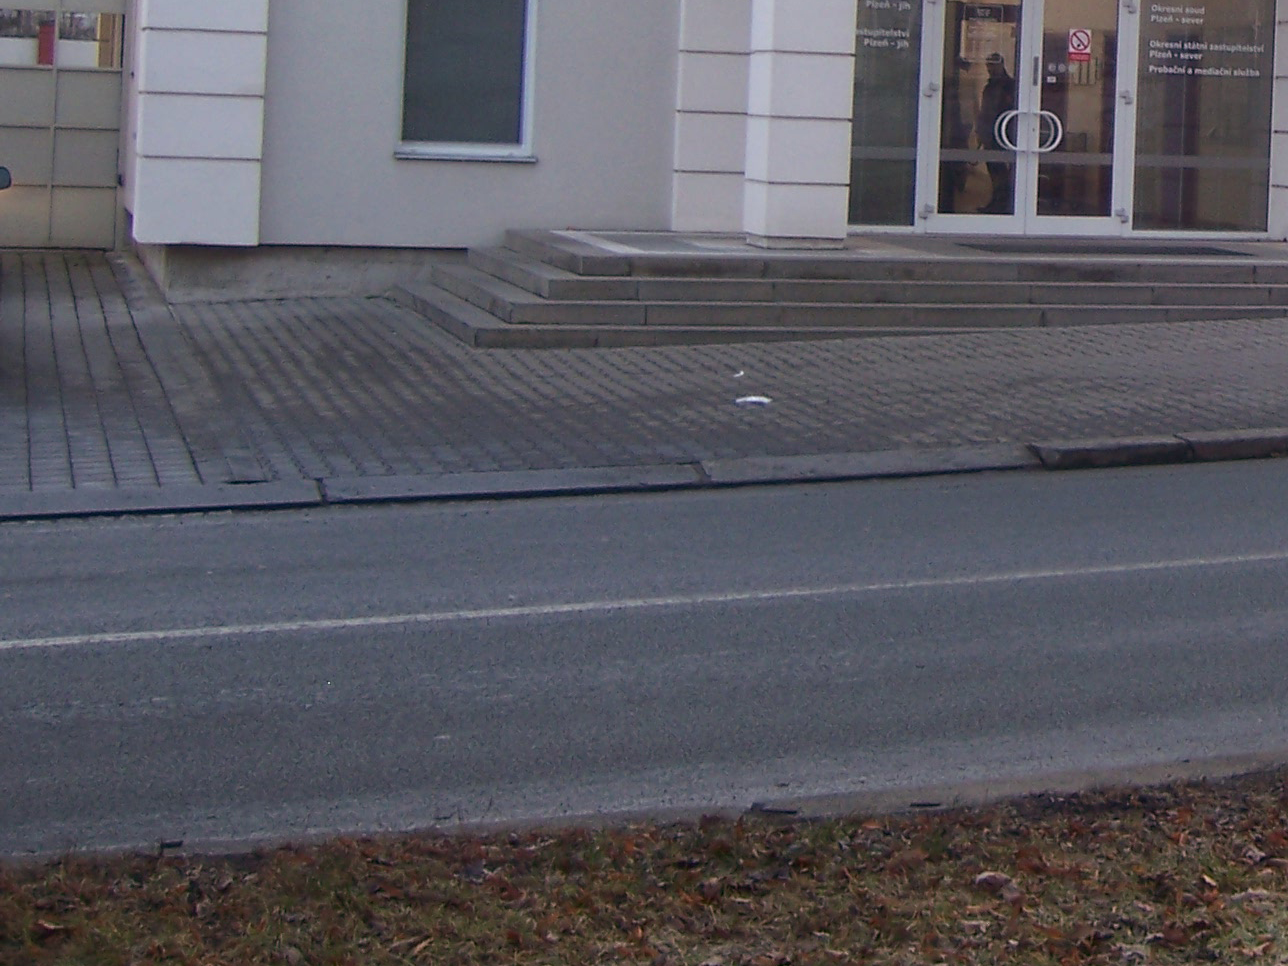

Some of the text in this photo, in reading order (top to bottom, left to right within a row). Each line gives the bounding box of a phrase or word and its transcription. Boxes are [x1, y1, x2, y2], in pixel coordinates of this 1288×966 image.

[1151, 4, 1205, 14] Okresní soud
[1150, 14, 1174, 24] Plzeň
[1181, 17, 1204, 25] sever
[1149, 40, 1182, 49] Okresní
[1183, 41, 1208, 51] státní
[1149, 50, 1173, 59] Plzeň
[1180, 52, 1203, 60] sever
[1149, 65, 1260, 77] Probační a mediační služba
